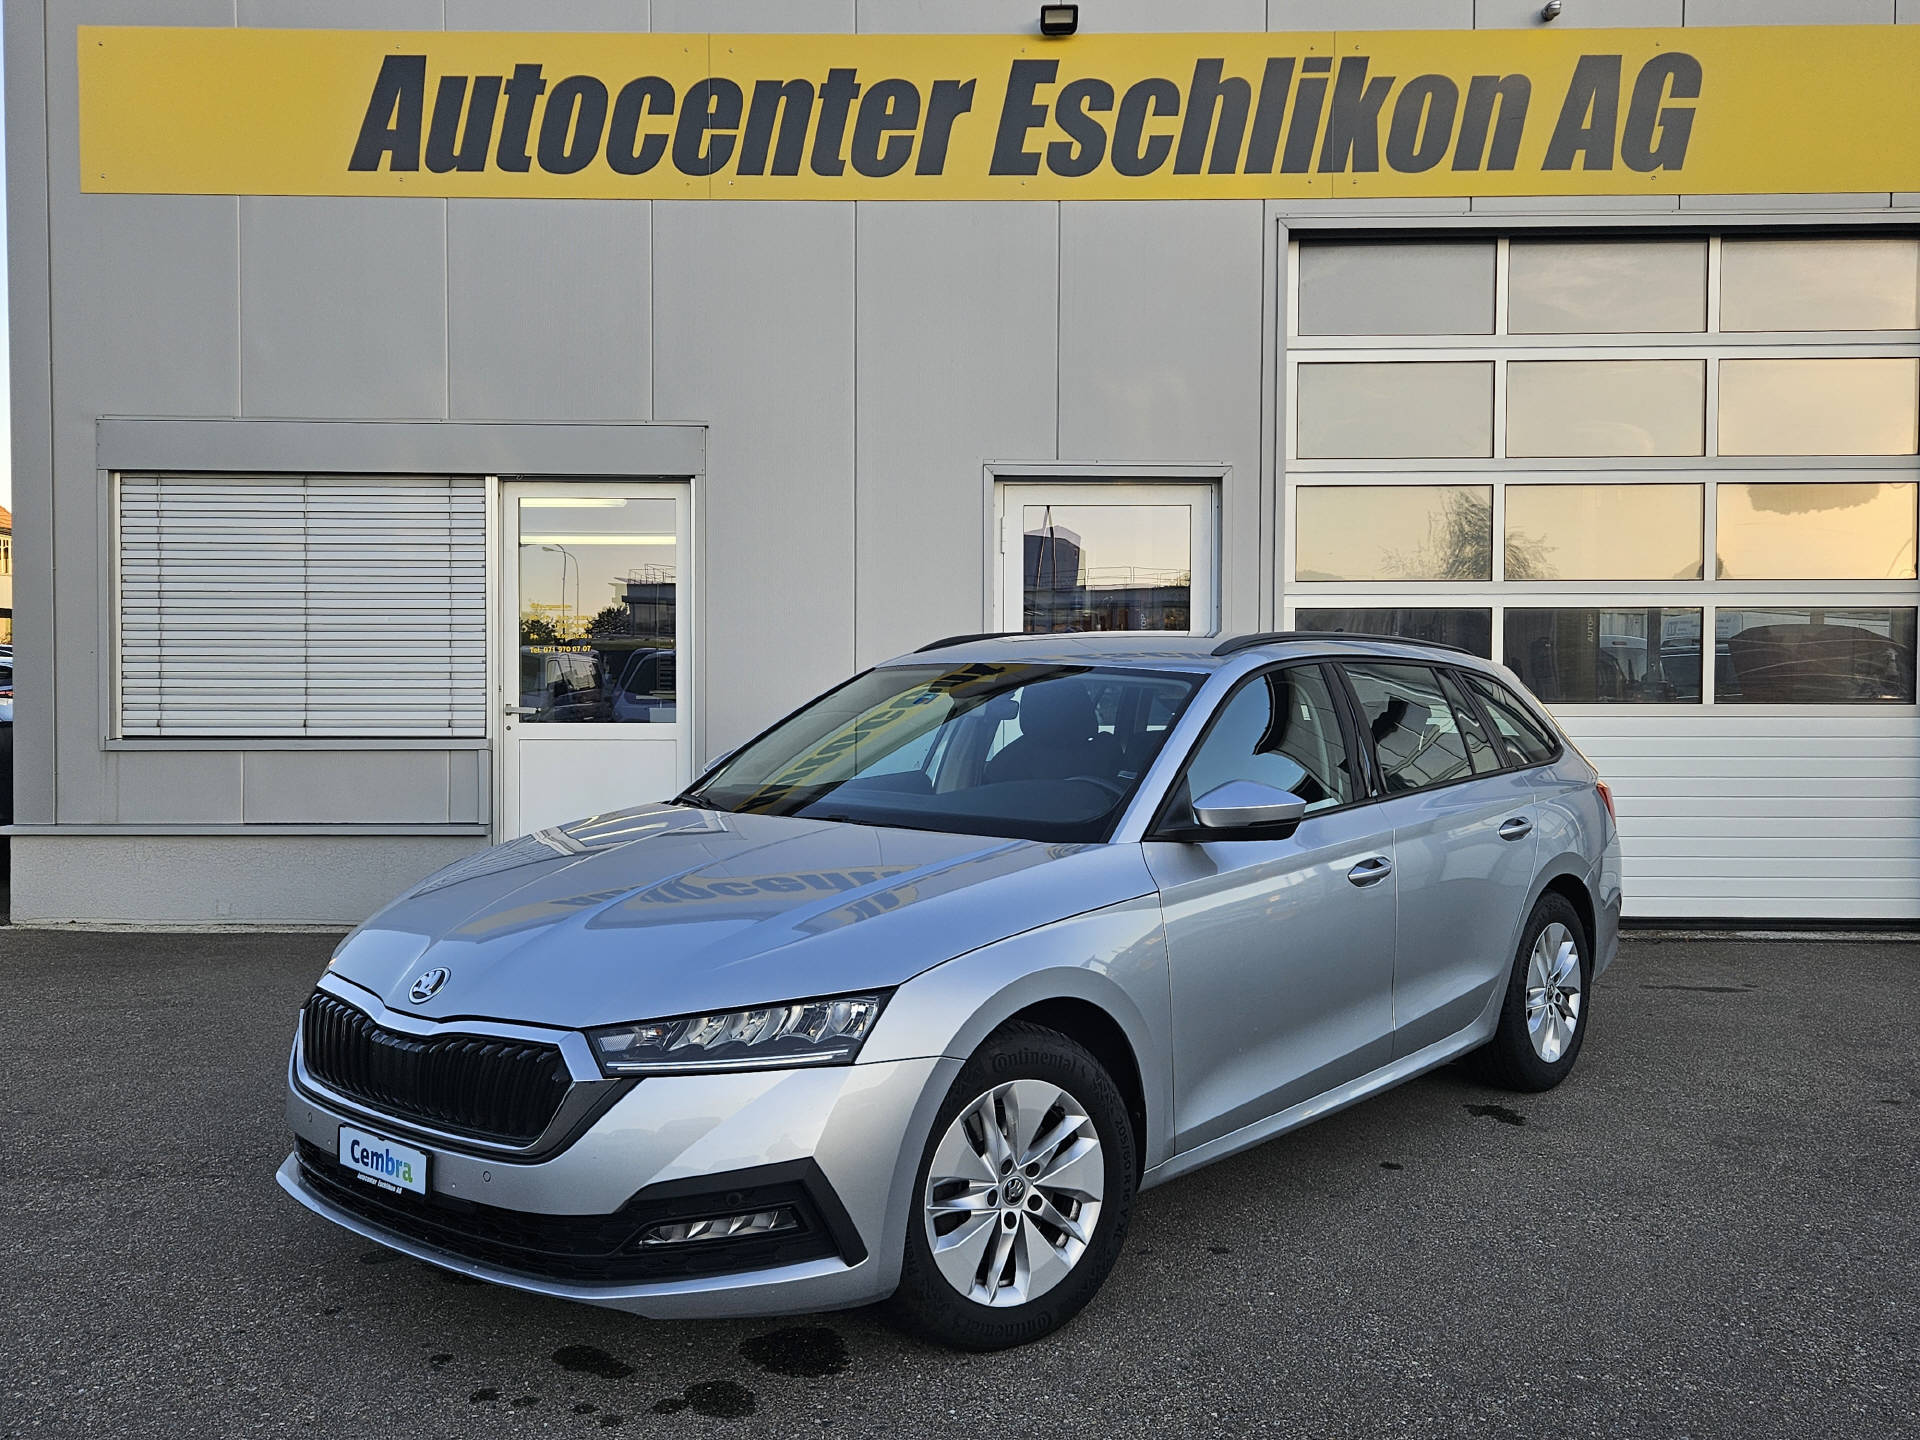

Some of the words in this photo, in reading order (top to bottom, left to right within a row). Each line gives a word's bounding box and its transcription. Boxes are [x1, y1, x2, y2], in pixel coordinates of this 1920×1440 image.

[347, 54, 976, 178] Autocenter
[988, 56, 1532, 178] Eschlikon
[1540, 52, 1703, 173] AG
[558, 645, 571, 653] 970
[351, 1139, 413, 1183] Cembra
